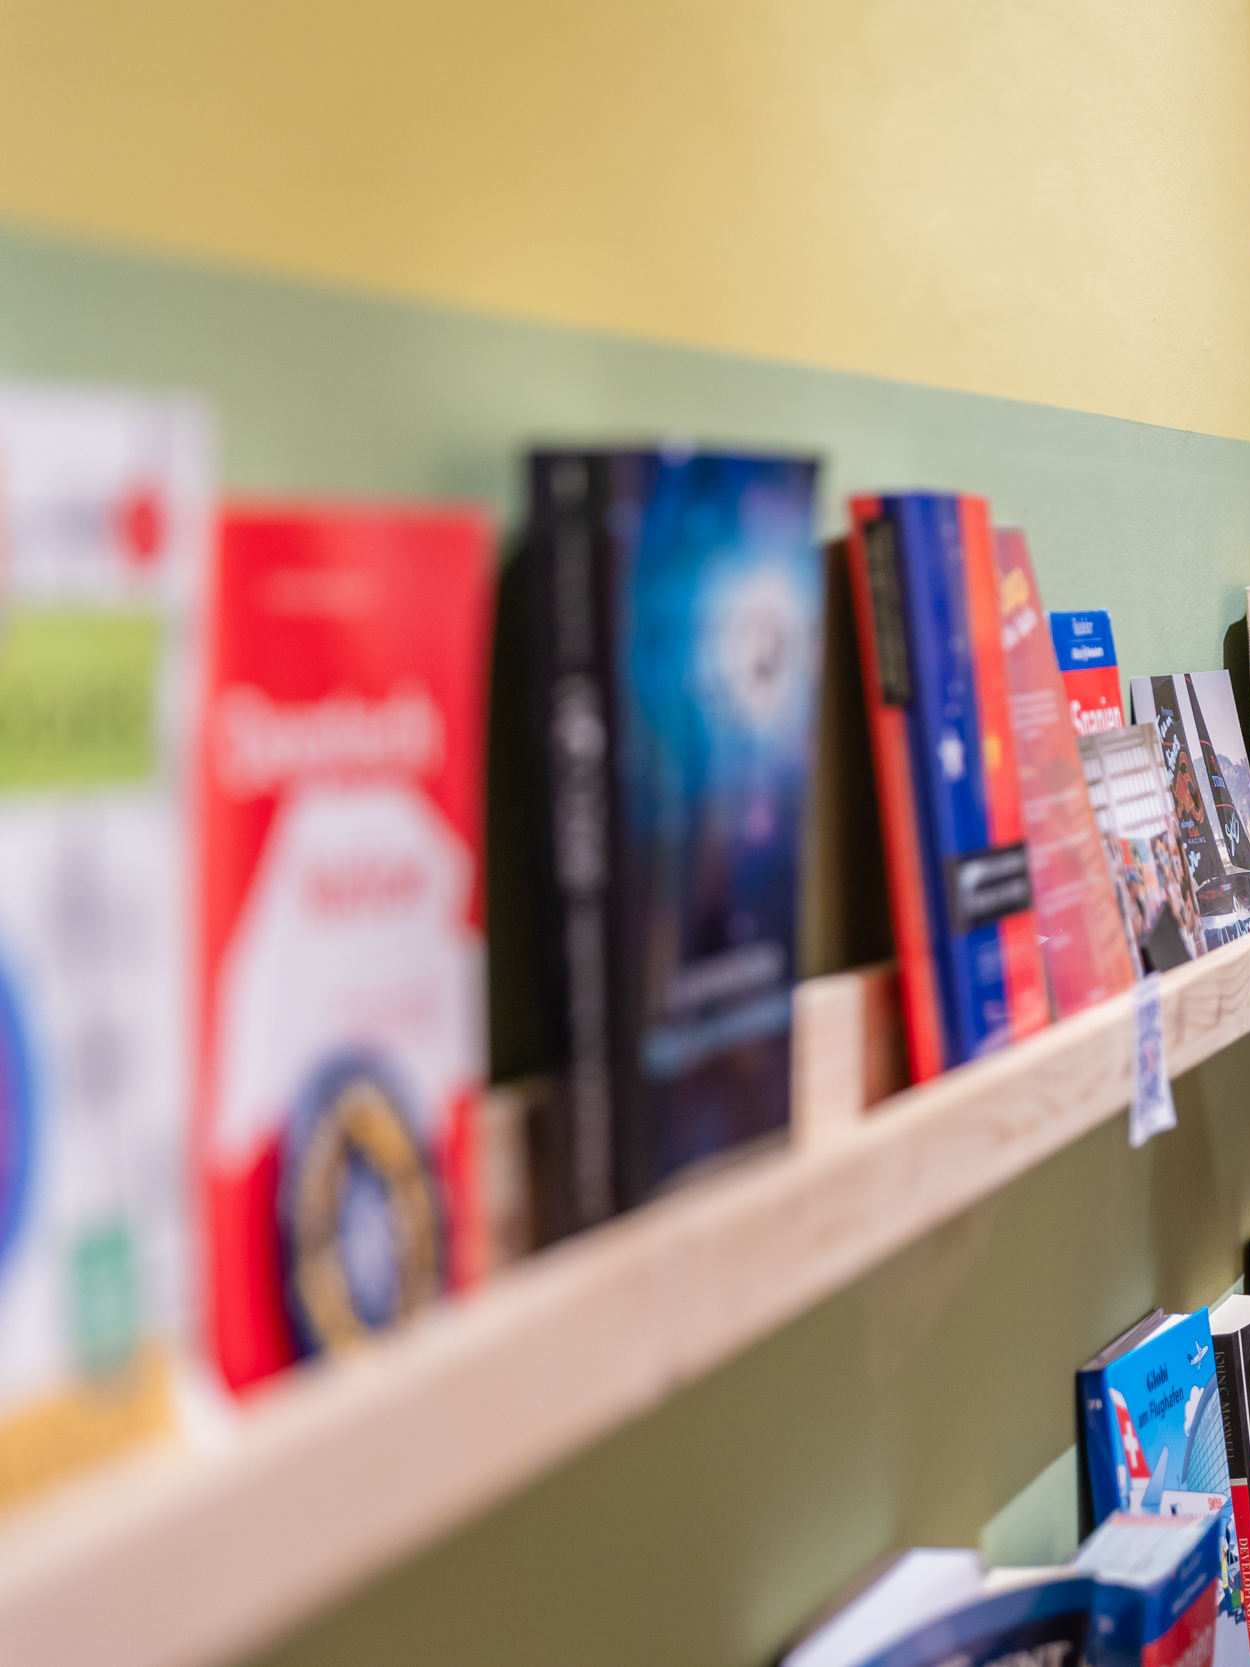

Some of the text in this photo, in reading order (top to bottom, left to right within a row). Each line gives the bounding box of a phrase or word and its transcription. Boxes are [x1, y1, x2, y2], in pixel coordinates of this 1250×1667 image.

[1146, 1362, 1169, 1392] Globi
[1214, 1351, 1227, 1384] JOHN
[1138, 1385, 1185, 1429] am Flughafen
